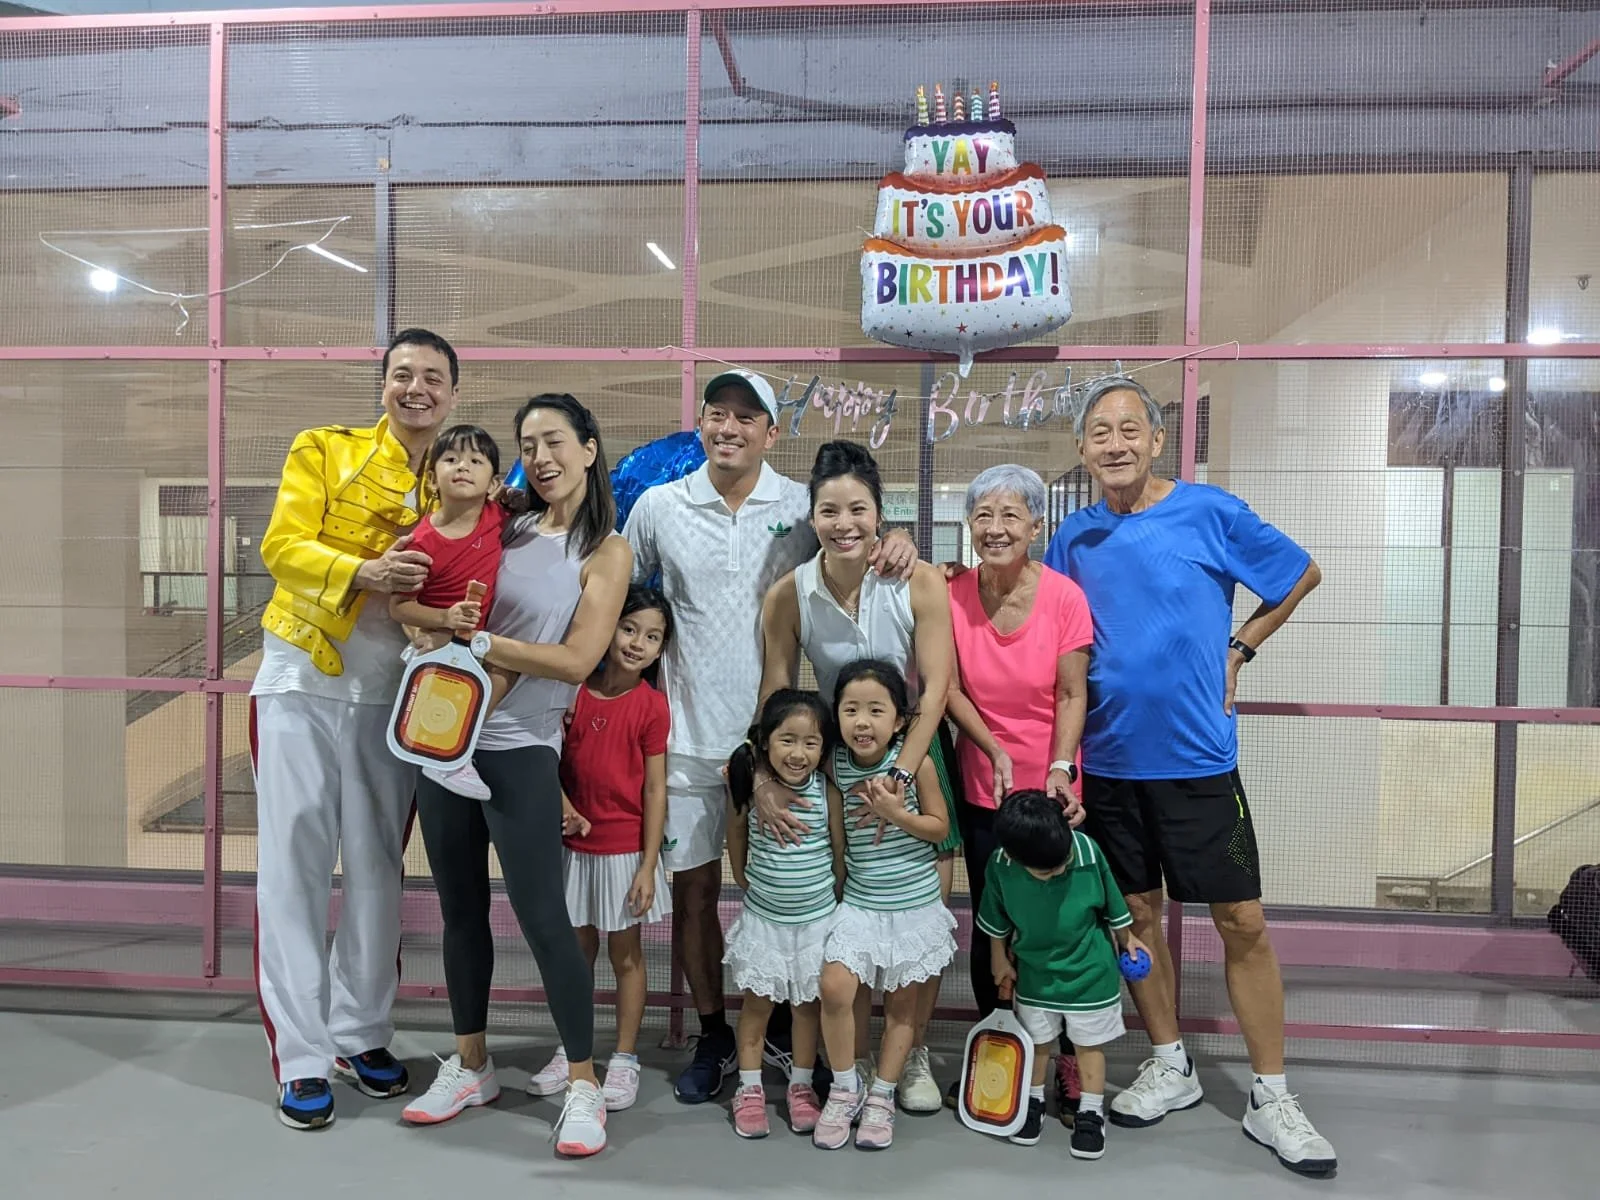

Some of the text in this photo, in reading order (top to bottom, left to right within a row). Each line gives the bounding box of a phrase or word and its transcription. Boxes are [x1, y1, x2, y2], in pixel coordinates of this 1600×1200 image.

[931, 138, 990, 176] YAY
[892, 190, 1035, 239] IT'S YOUR
[877, 252, 1060, 305] BIRTHDAY!
[776, 374, 899, 449] Happy
